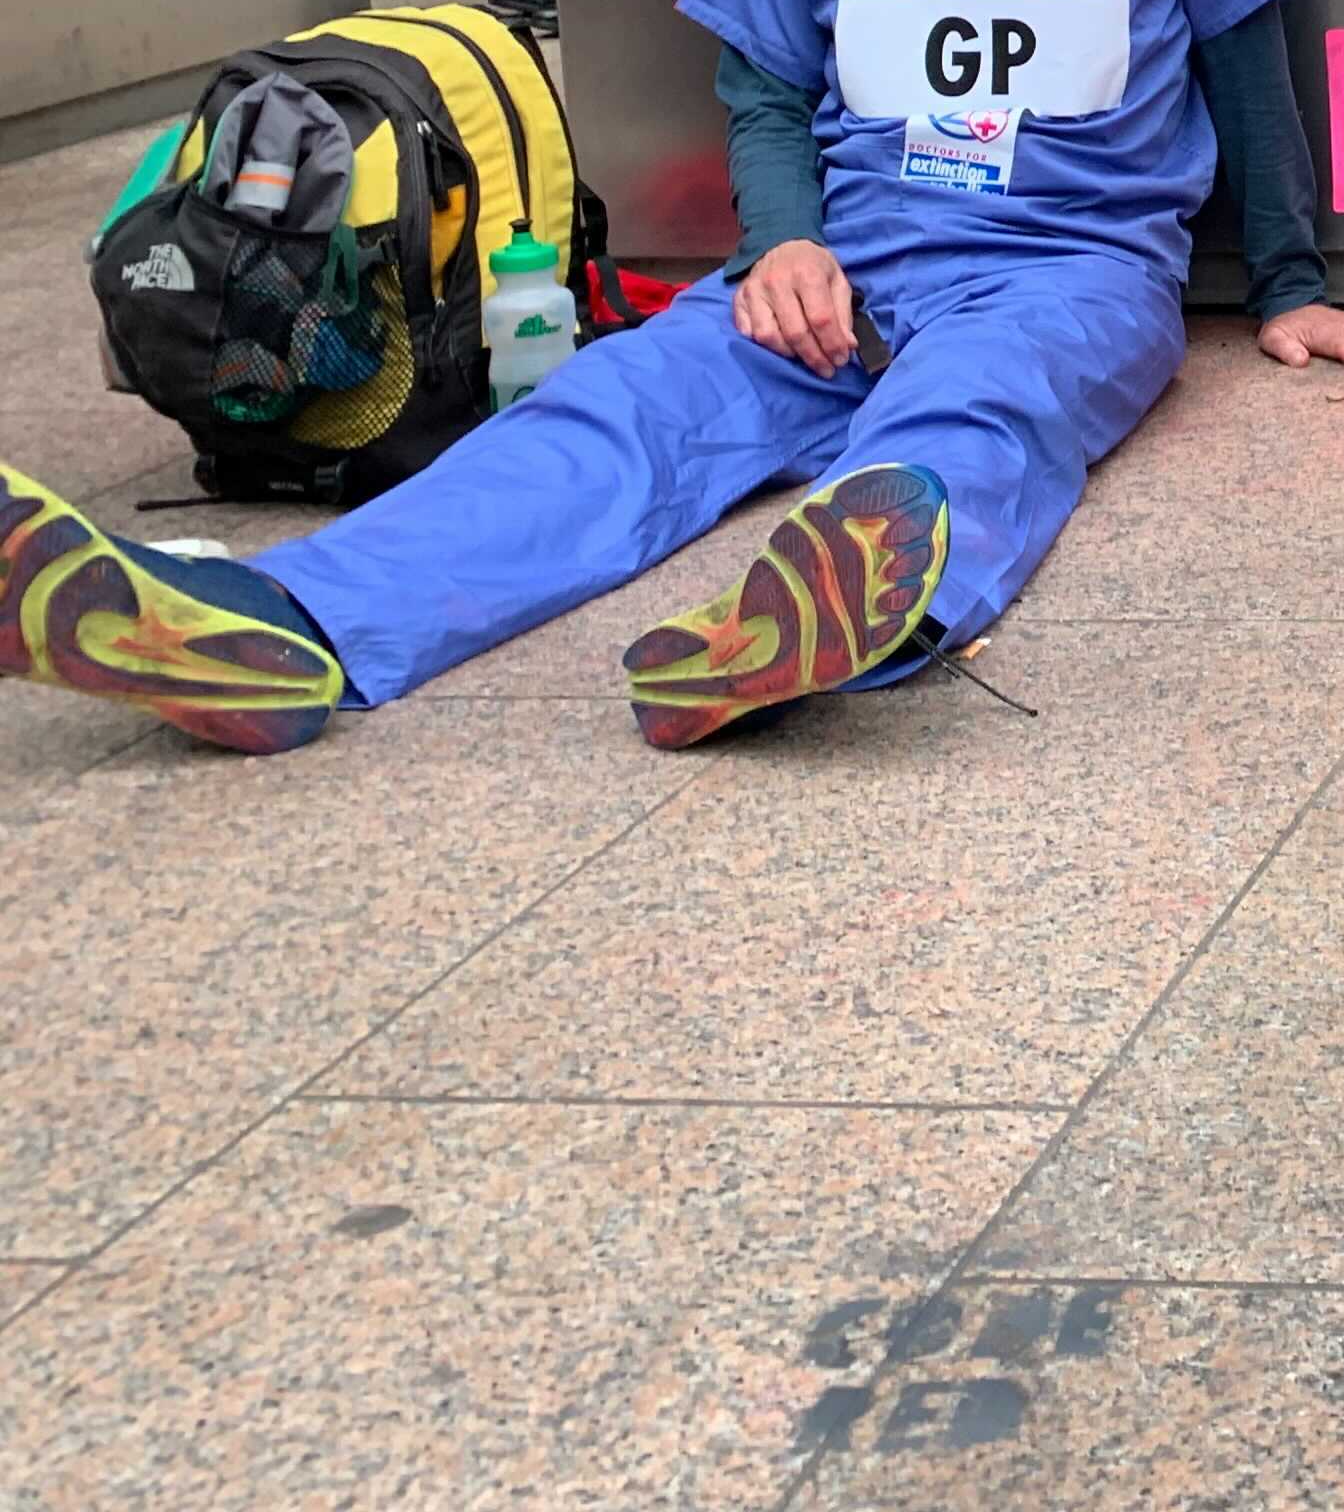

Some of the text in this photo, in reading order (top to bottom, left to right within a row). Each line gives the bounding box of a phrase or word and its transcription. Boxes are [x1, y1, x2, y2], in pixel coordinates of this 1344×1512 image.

[925, 16, 1037, 97] GP
[908, 143, 988, 162] DOCTORS FOR
[909, 156, 989, 183] extinction
